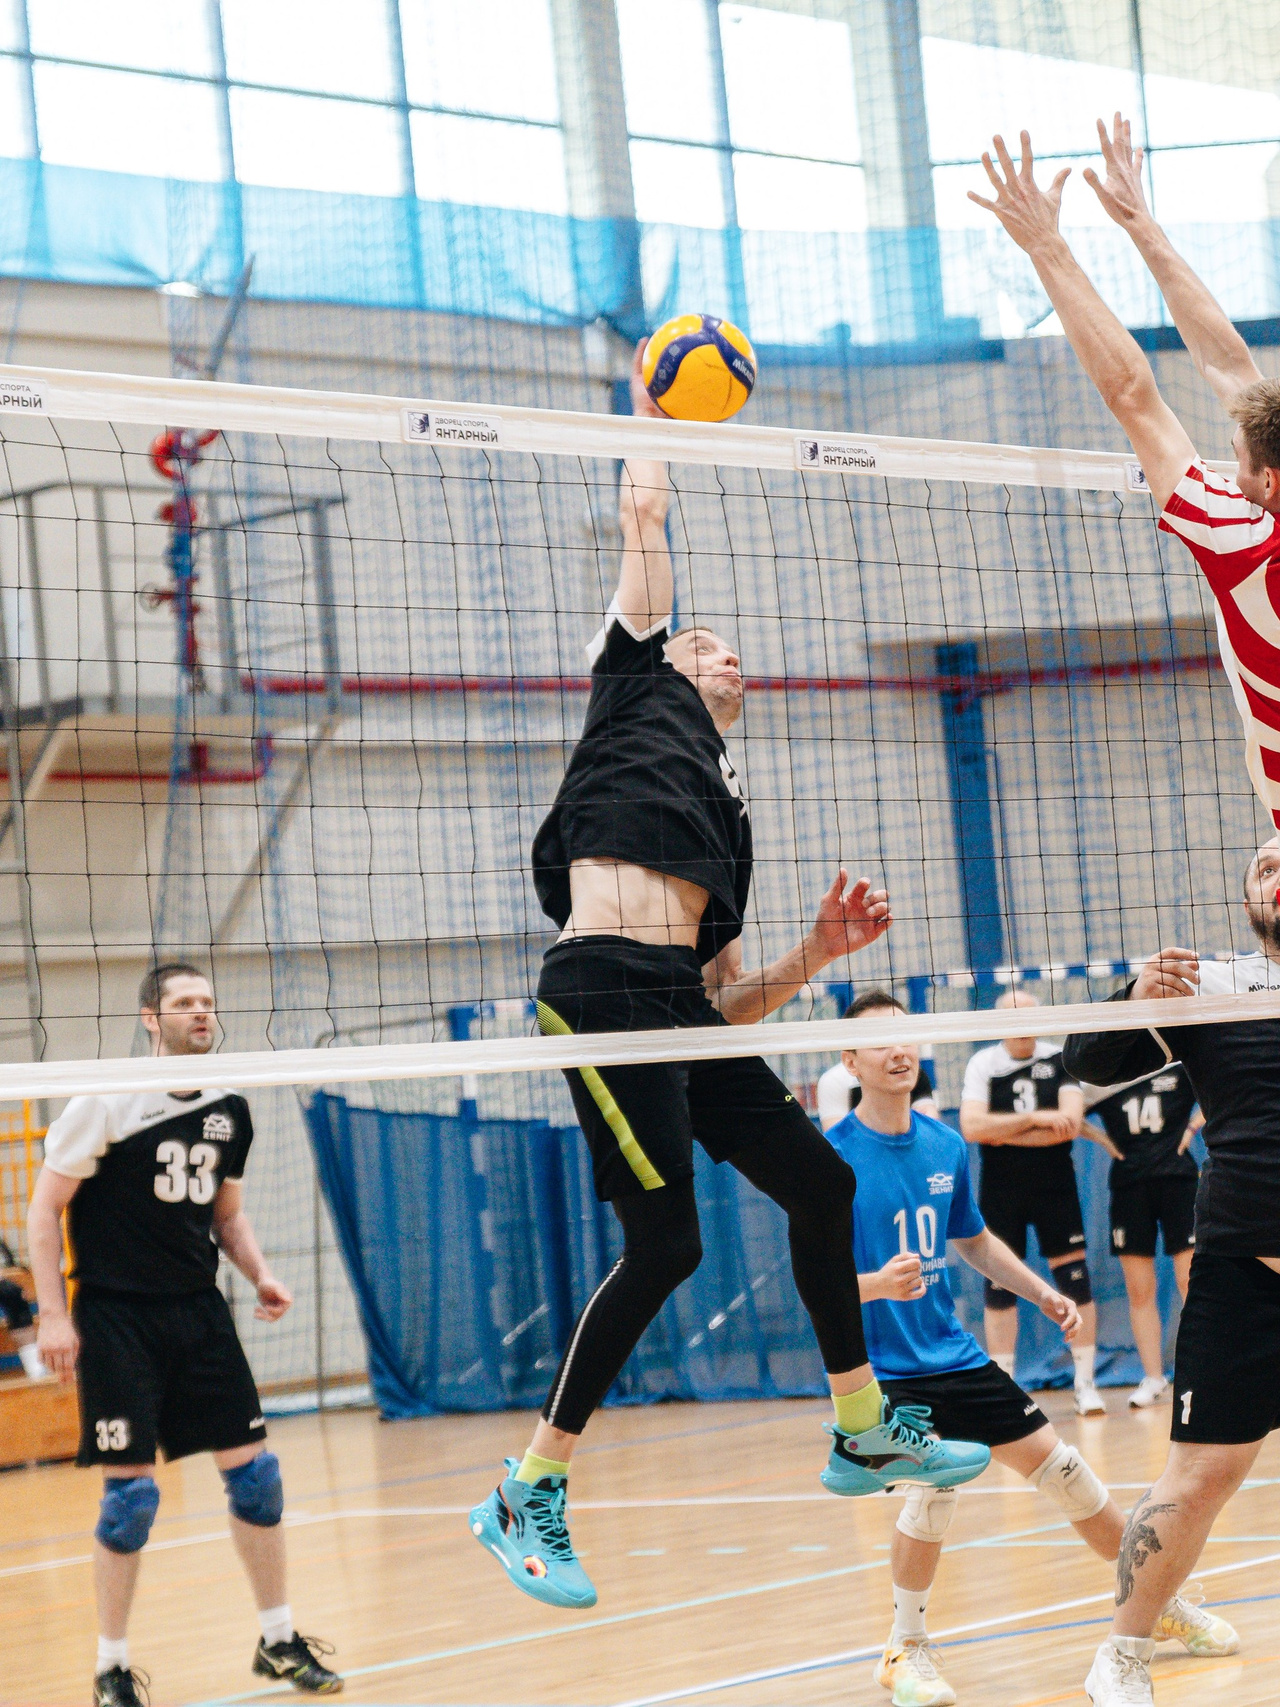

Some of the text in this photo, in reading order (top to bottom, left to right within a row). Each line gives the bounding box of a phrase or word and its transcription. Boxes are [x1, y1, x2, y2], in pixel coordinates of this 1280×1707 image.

[0, 383, 31, 392] СПОРТА
[0, 394, 42, 408] РНЫЙ
[435, 417, 489, 428] ДВОРЕЦ СПОРТА
[436, 428, 498, 442] ЯНТАРНЫЙ
[823, 445, 868, 455] ДВОРЕЦ СПОРТА
[824, 455, 876, 468] ЯНТАРНЫЙ
[1013, 1079, 1037, 1113] 3
[1122, 1096, 1164, 1134] 14
[154, 1141, 217, 1205] 33
[929, 1186, 954, 1195] ЗЕНИТ
[893, 1206, 936, 1258] 10
[1180, 1391, 1193, 1425] 1
[95, 1418, 128, 1451] 33
